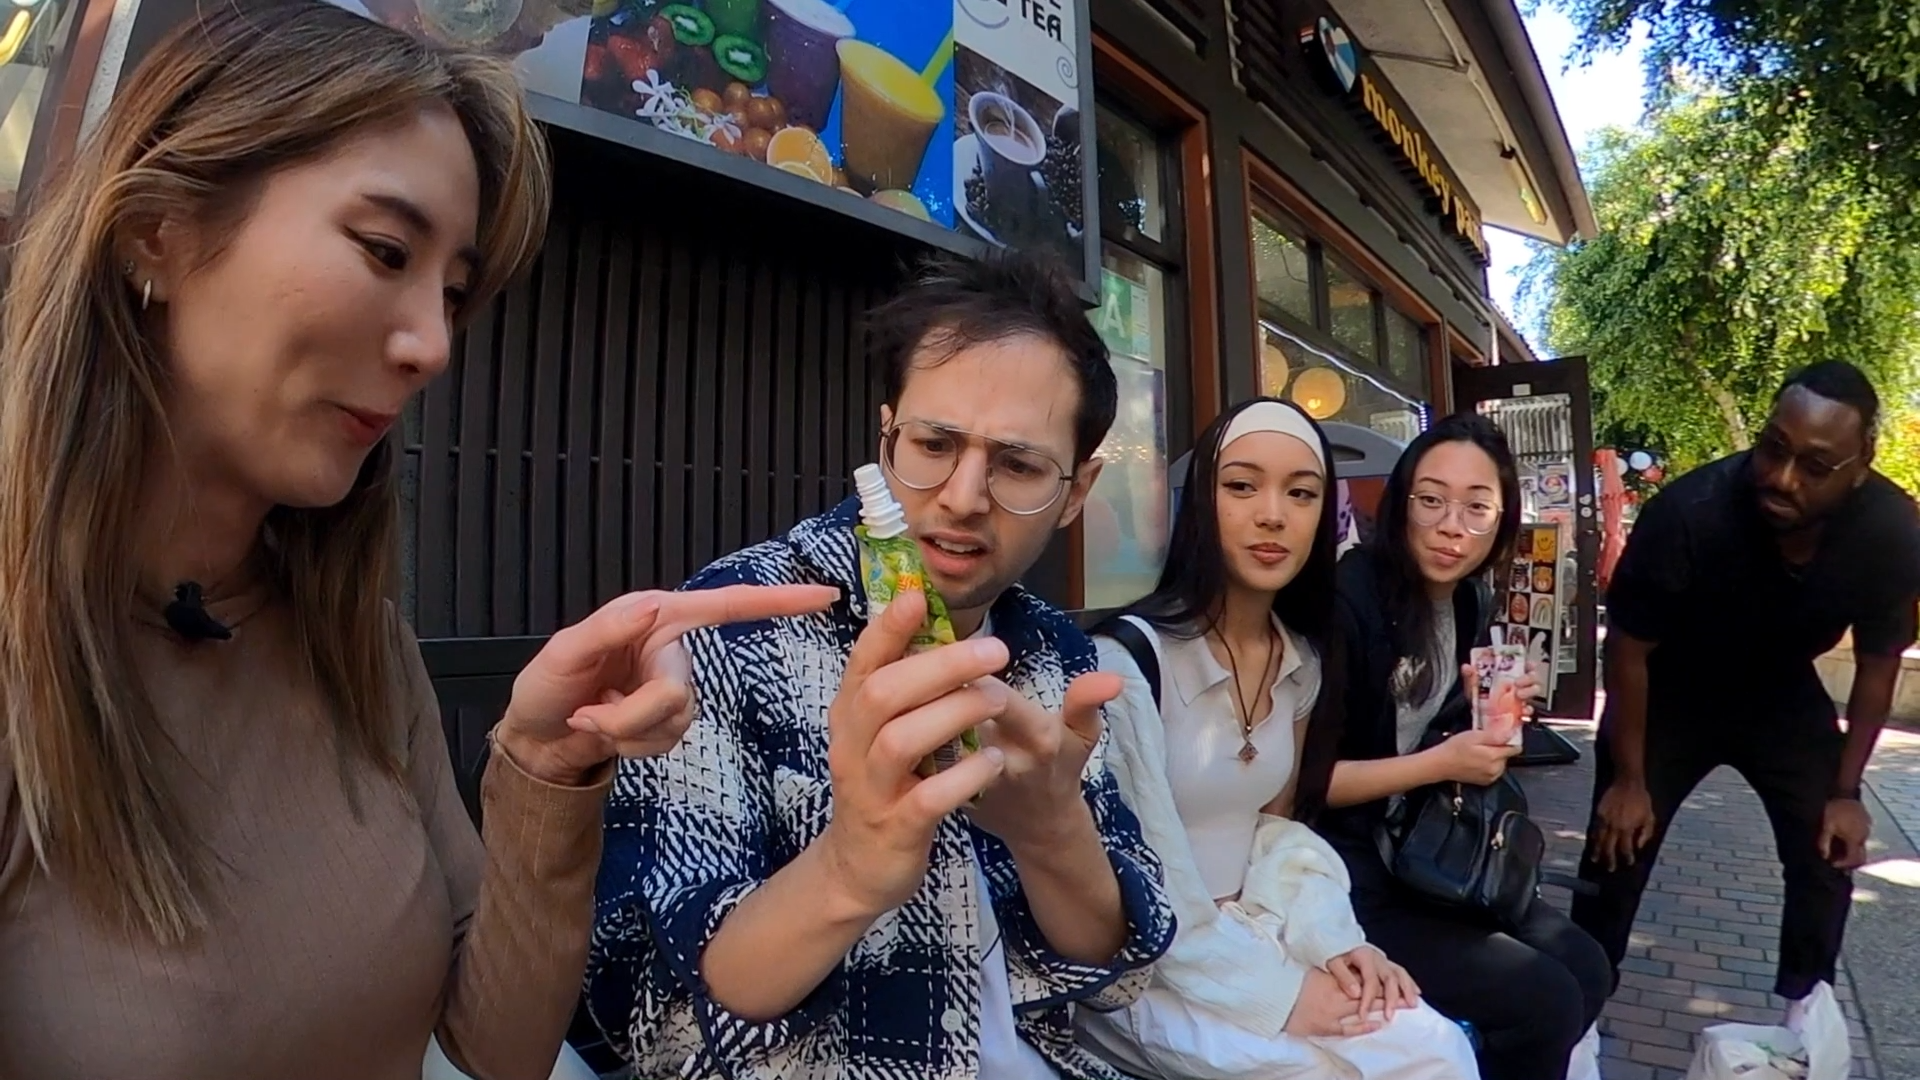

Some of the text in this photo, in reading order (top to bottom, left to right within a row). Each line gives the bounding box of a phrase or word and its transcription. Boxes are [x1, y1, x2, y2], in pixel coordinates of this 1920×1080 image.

[1021, 0, 1062, 42] TEA
[1360, 73, 1450, 215] monkey
[1102, 292, 1125, 338] A
